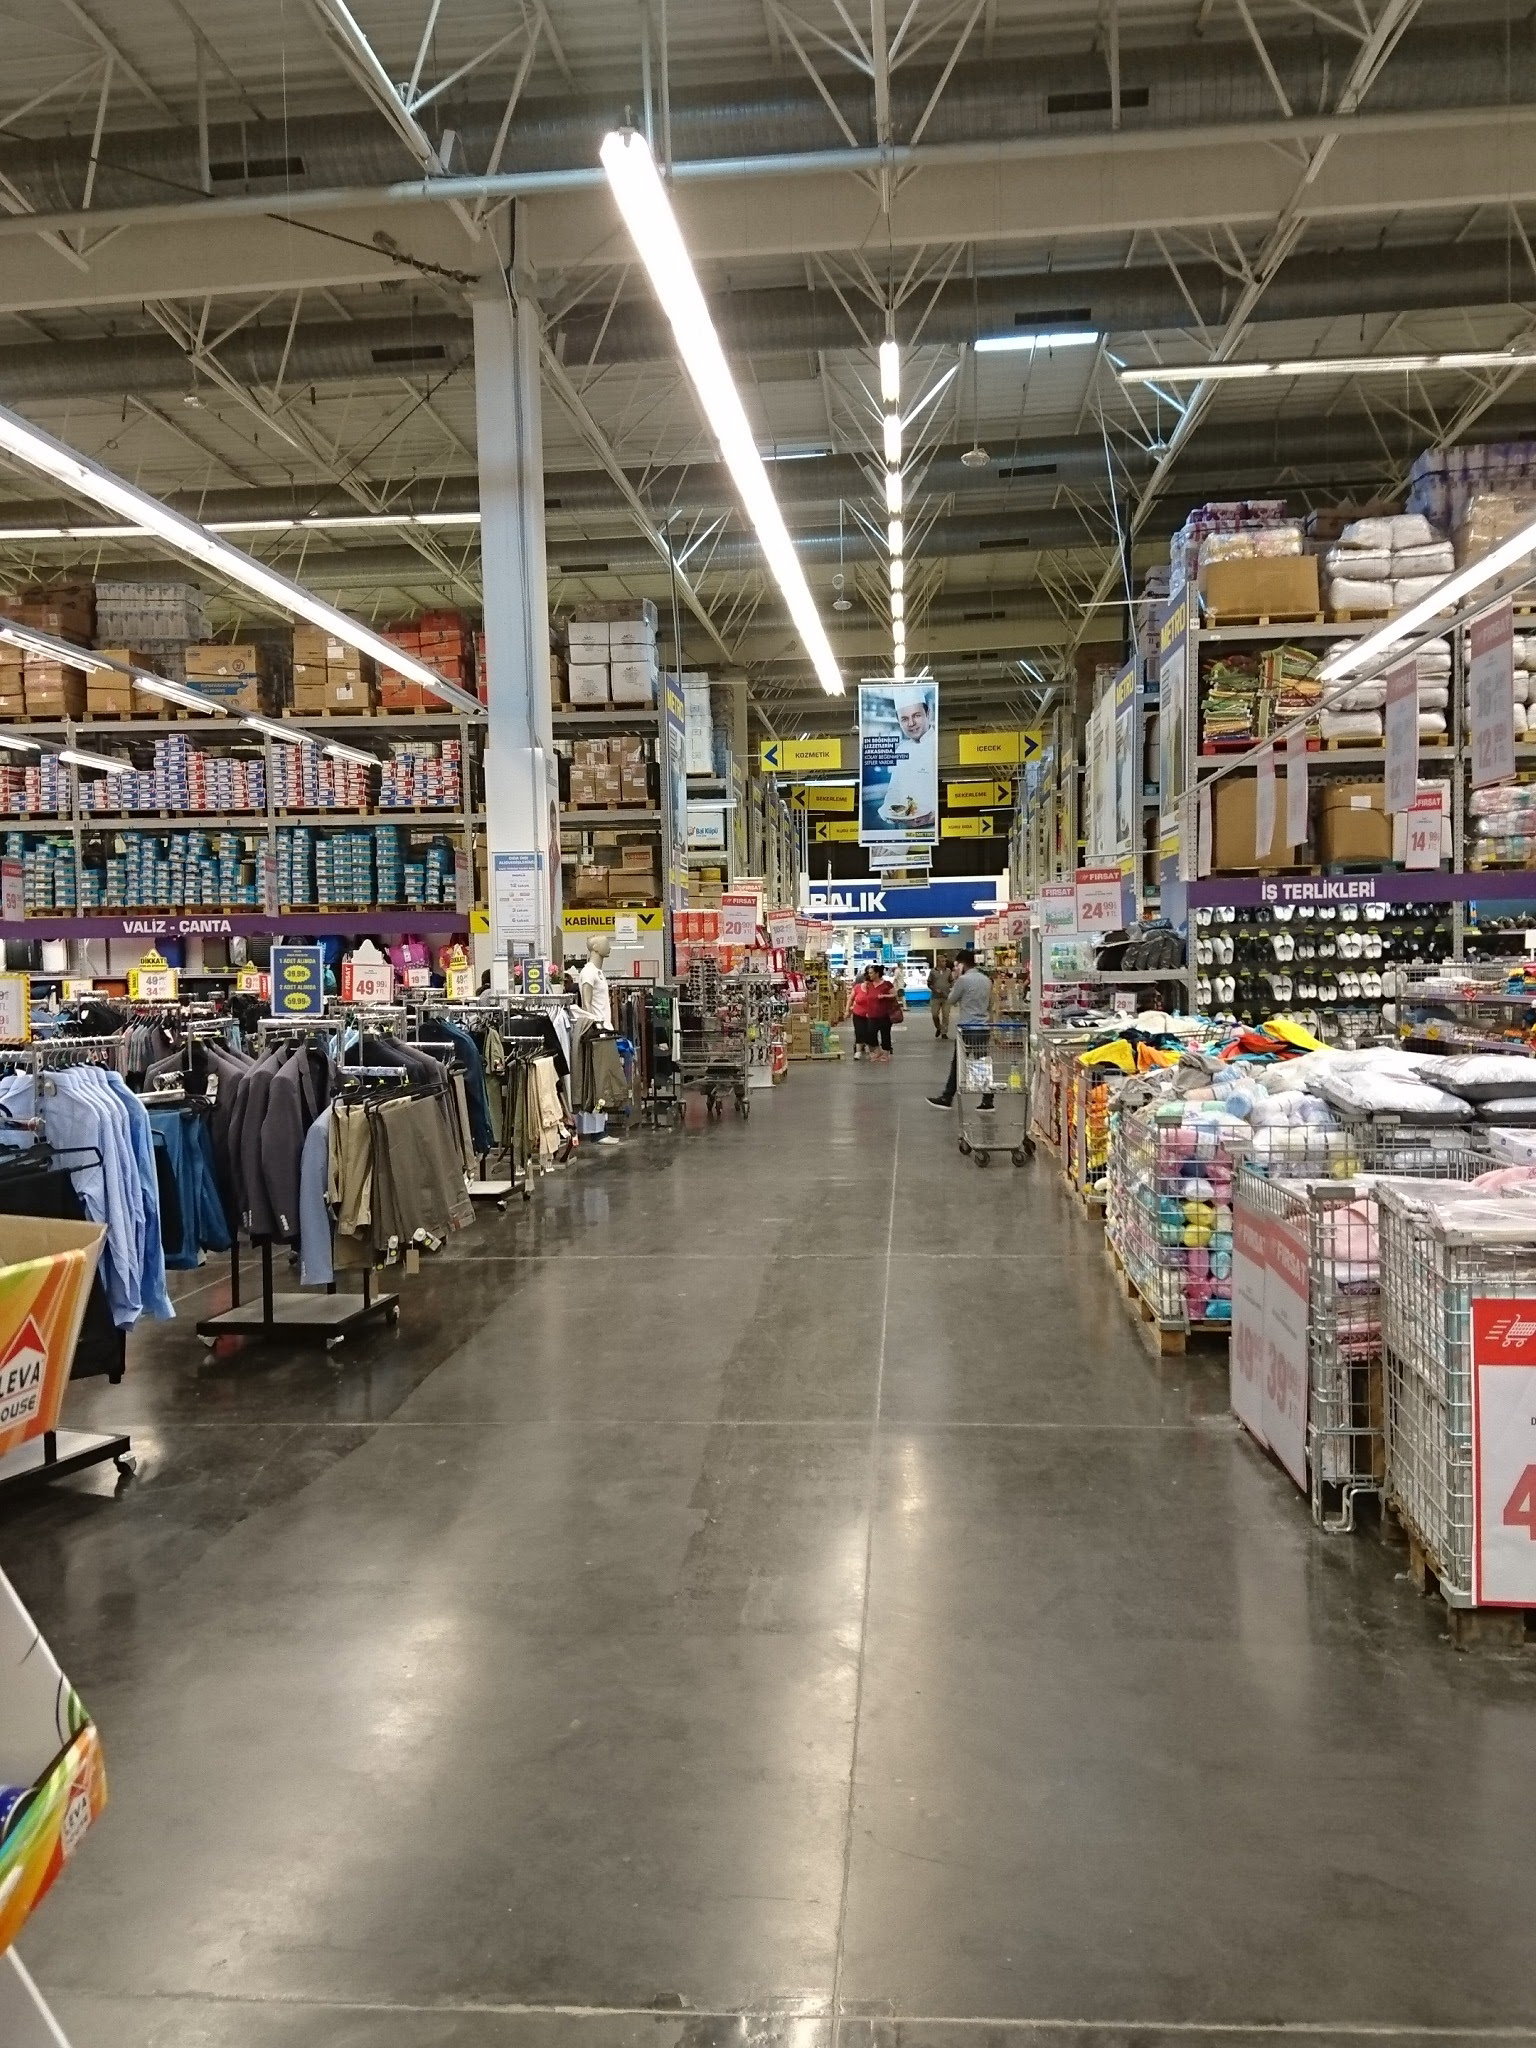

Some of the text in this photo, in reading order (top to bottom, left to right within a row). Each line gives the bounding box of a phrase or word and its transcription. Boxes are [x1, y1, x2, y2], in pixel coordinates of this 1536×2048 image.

[1161, 601, 1186, 654] METRO
[795, 751, 830, 759] KOZMETİK
[1416, 797, 1441, 808] FIRSAT
[1412, 831, 1425, 852] 14
[1089, 872, 1120, 880] FIRSAT
[1045, 888, 1072, 896] FIRSAT
[1261, 878, 1376, 903] İŞ TERLİKLERİ
[810, 891, 887, 914] BALIK
[1082, 903, 1104, 920] 24
[123, 919, 166, 934] VALİZ
[179, 919, 232, 935] ÇANTA
[725, 921, 742, 935] 20
[356, 980, 375, 996] 49
[1116, 1000, 1127, 1009] 29
[1276, 1240, 1307, 1287] FIRSAT
